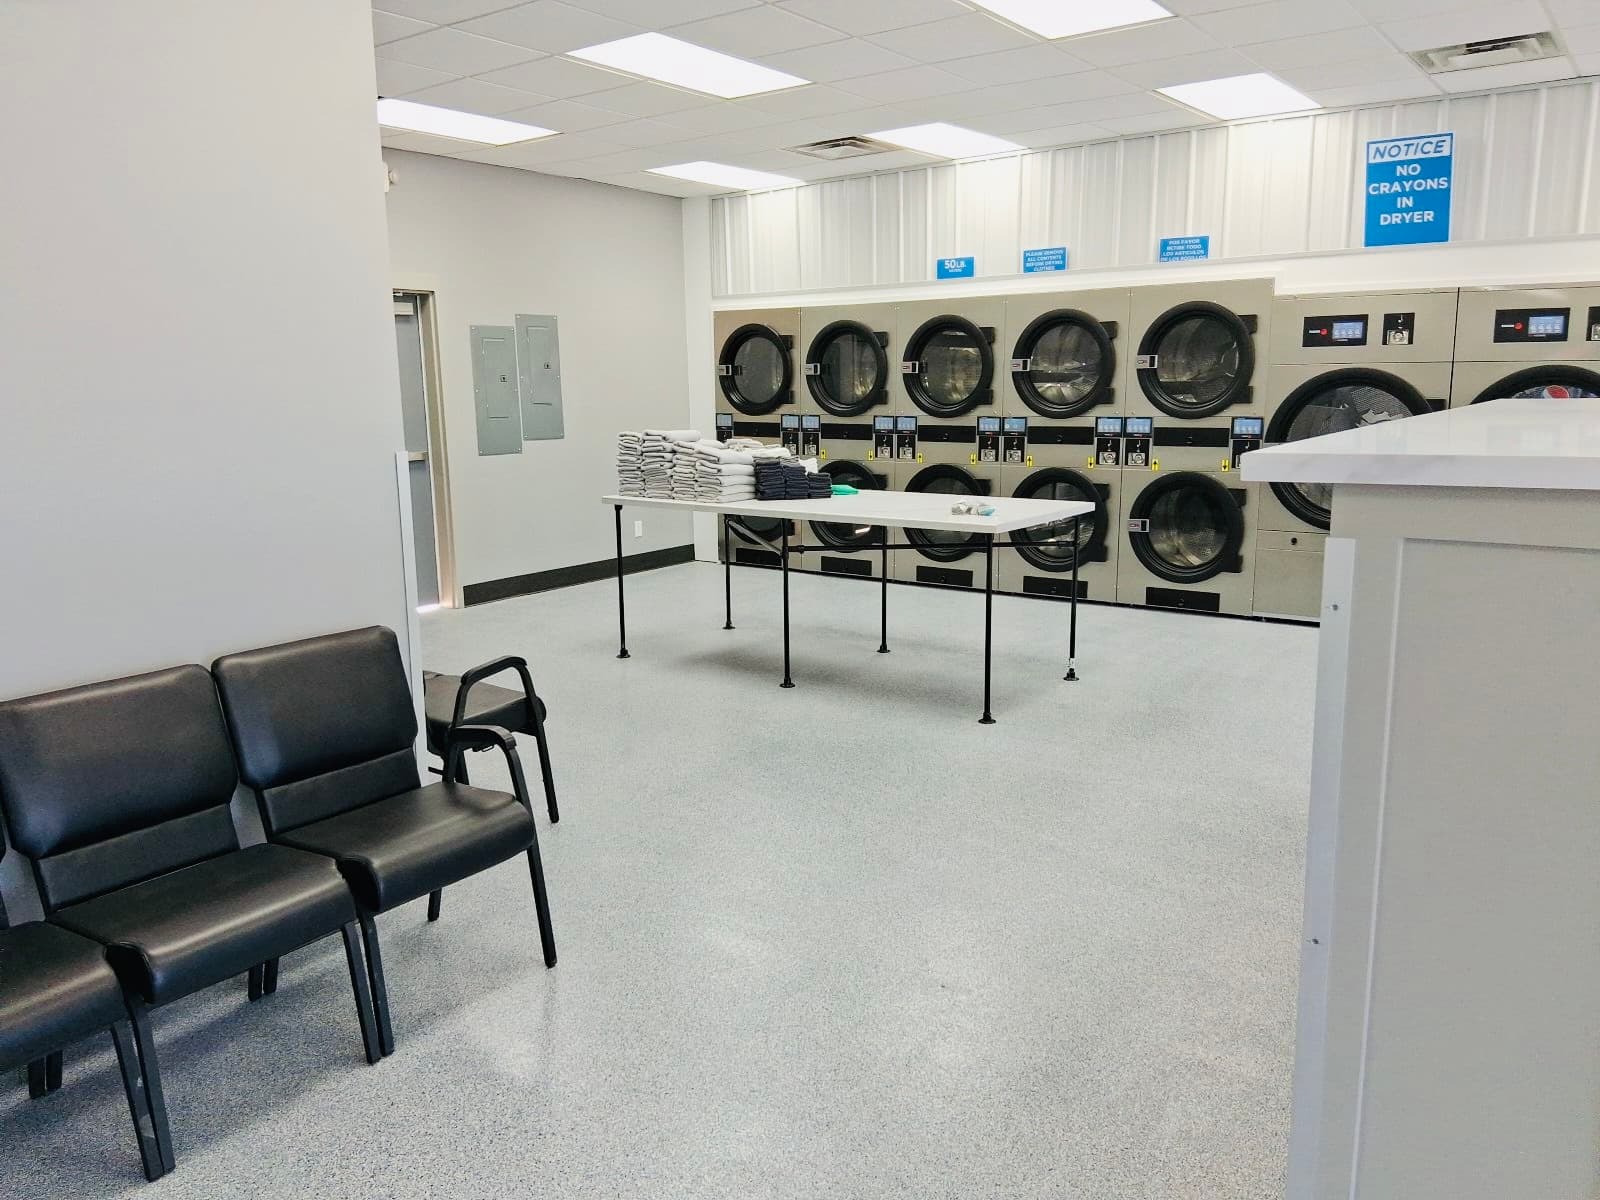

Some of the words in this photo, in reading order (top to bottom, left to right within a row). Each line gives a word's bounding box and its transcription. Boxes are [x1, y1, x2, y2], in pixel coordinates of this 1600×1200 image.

[1373, 139, 1446, 160] NOTICE
[1396, 163, 1421, 177] NO
[1368, 177, 1448, 194] CRAYONS
[1396, 196, 1414, 209] IN
[1379, 211, 1435, 226] DRYER
